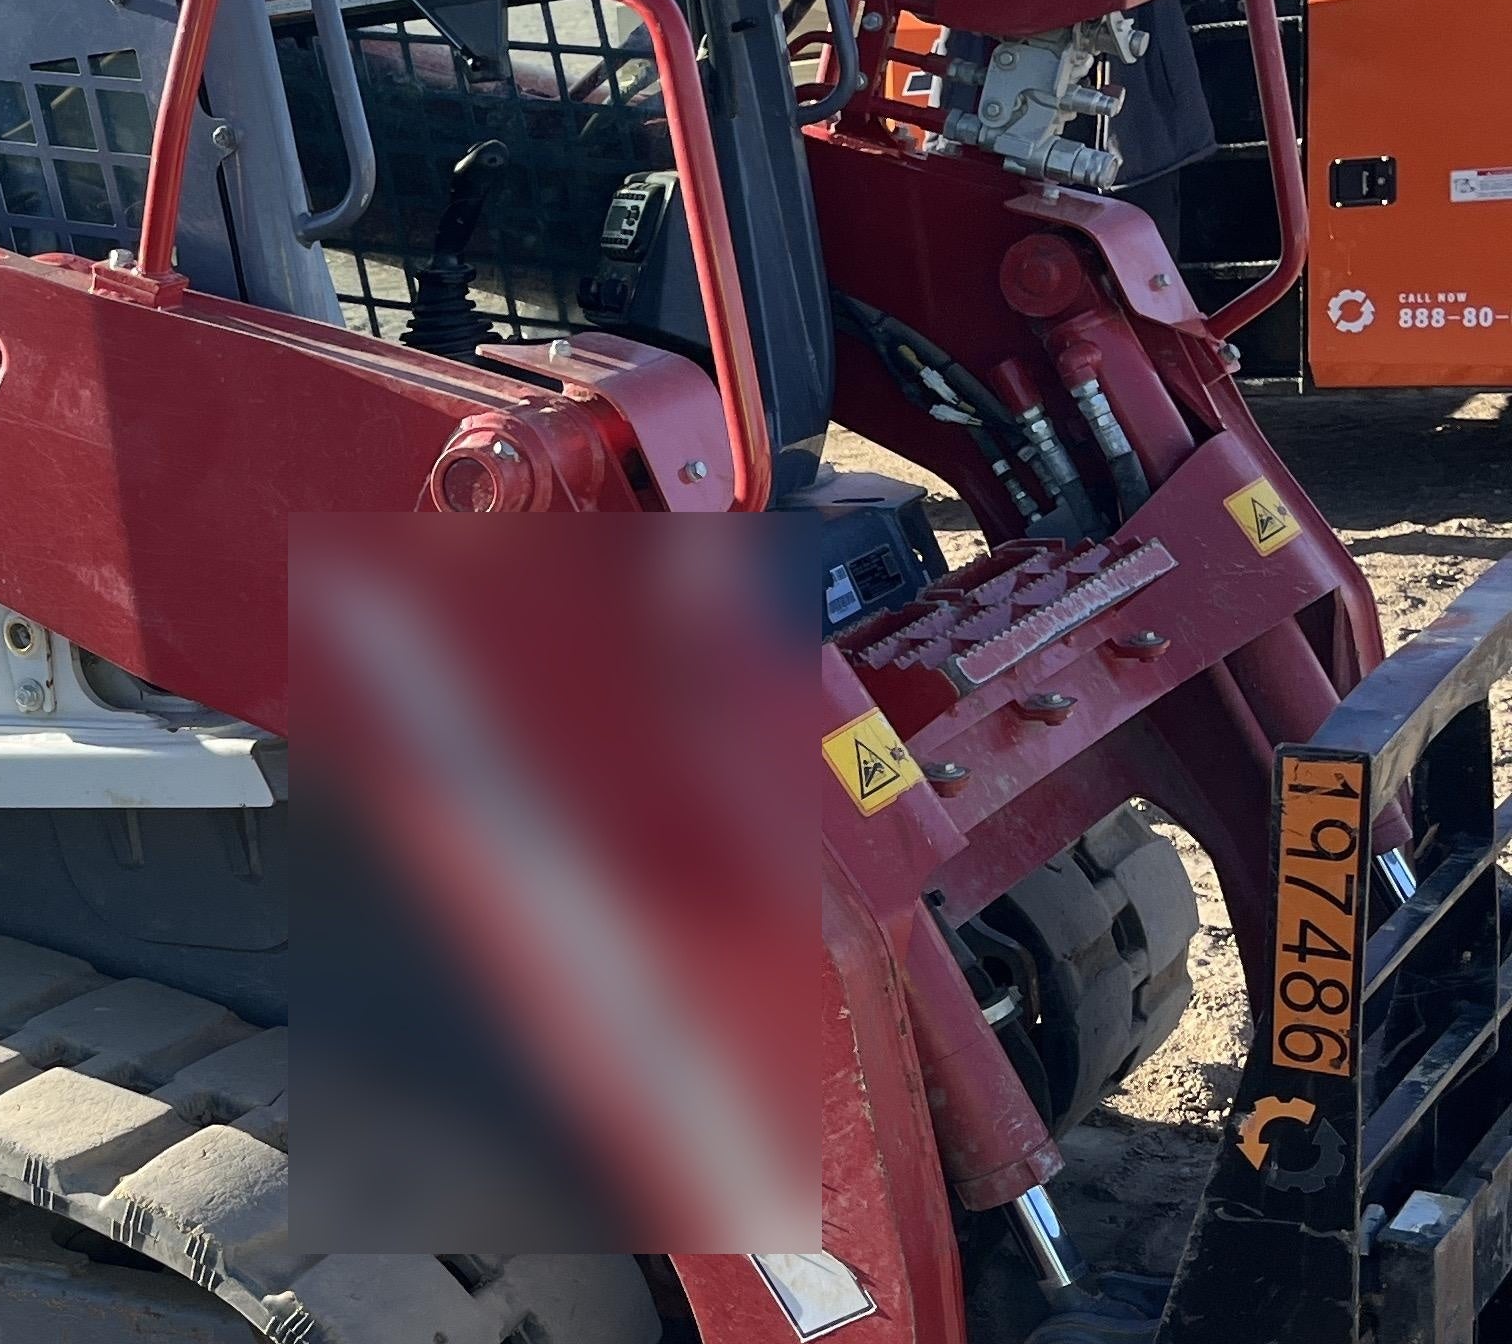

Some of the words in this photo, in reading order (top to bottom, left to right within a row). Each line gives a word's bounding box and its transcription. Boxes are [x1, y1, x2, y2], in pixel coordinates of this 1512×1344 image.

[1398, 292, 1431, 304] CALL
[1437, 291, 1468, 303] NOW
[1398, 306, 1512, 329] 888-80-
[1277, 771, 1361, 1070] 197486
